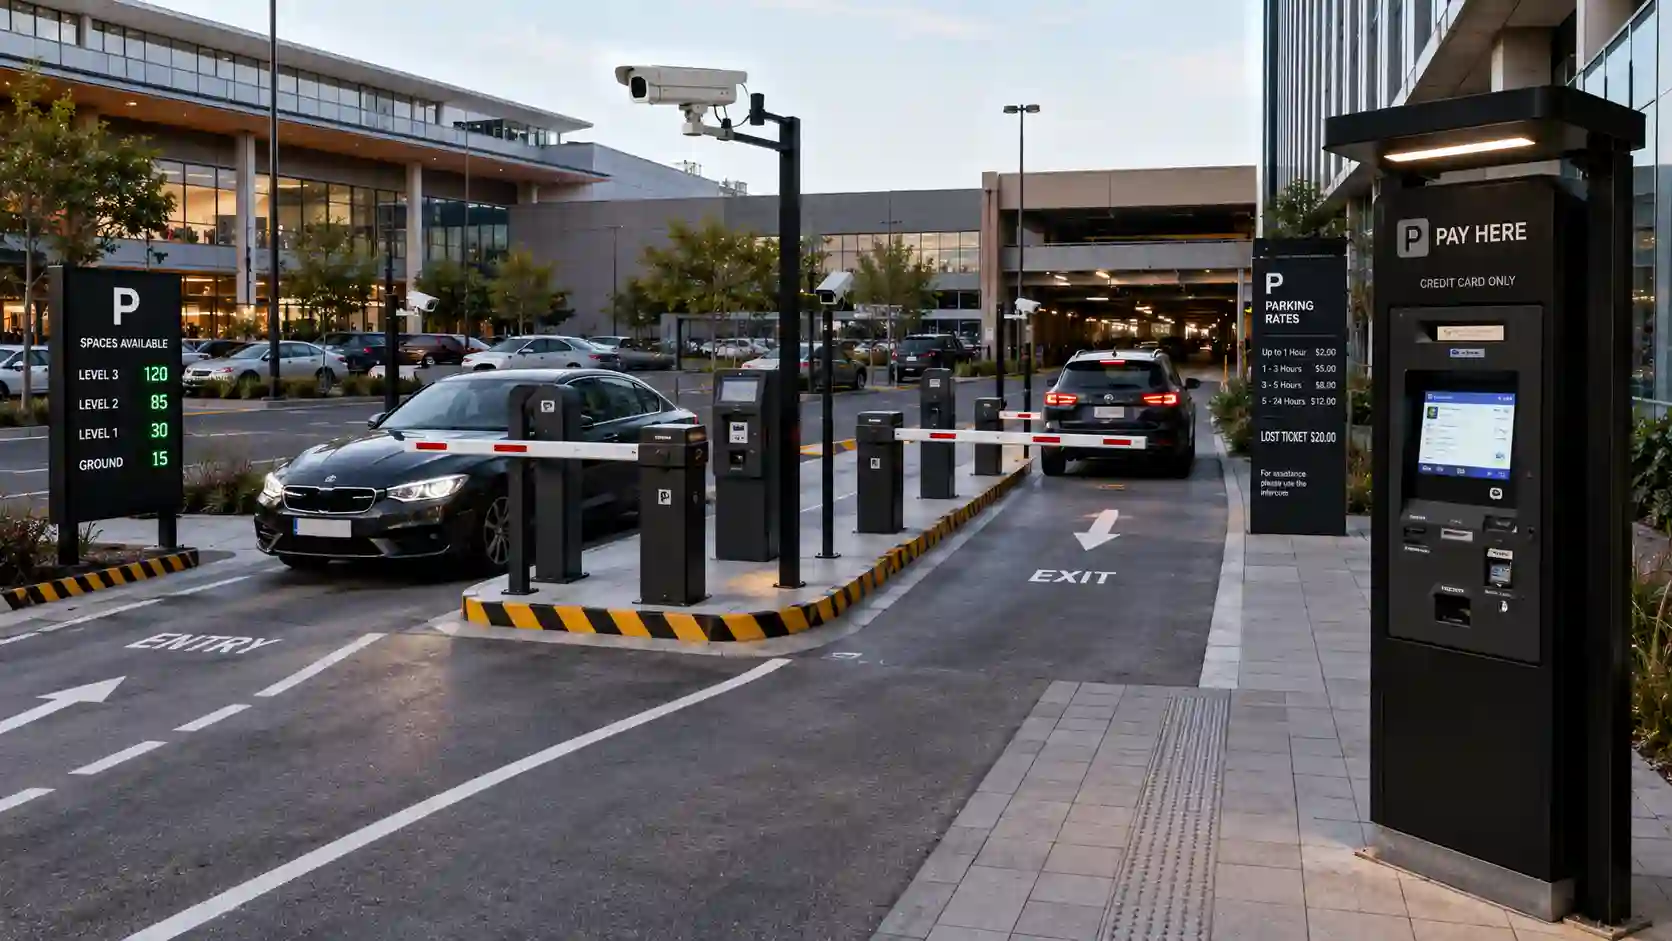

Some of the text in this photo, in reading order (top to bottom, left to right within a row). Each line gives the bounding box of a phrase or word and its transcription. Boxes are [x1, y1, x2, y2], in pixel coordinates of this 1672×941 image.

[1405, 225, 1422, 253] P
[1436, 222, 1527, 246] PAY HERE
[1265, 272, 1283, 294] P
[1420, 276, 1516, 289] CREDIT CARD ONLY
[113, 287, 140, 325] P
[1265, 300, 1314, 311] PARKING
[1265, 314, 1300, 324] RATES
[80, 337, 168, 349] SPACES AVAILABLE
[1262, 348, 1273, 358] Up
[1274, 348, 1282, 356] to
[1289, 348, 1307, 356] Hour
[1315, 348, 1336, 356] $2.00
[79, 366, 168, 381] LEVEL 3 120
[1262, 365, 1266, 373] 1
[1273, 365, 1279, 373] 3
[1280, 365, 1302, 373] Hours
[1315, 364, 1336, 373] $5.00
[1261, 381, 1267, 389] 3
[1273, 381, 1279, 389] 5
[1280, 381, 1302, 389] Hours
[79, 394, 168, 410] LEVEL 2 85
[1262, 397, 1267, 405] 5
[1273, 397, 1282, 405] 24
[1284, 397, 1306, 405] Hours
[1310, 397, 1336, 406] $12.00
[79, 422, 168, 440] LEVEL 1 30
[1261, 431, 1337, 443] LOST TICKET $20.00
[79, 451, 168, 471] GROUND 15
[1261, 469, 1271, 477] For
[1028, 569, 1117, 584] EXIT
[124, 632, 283, 654] ENTRY
